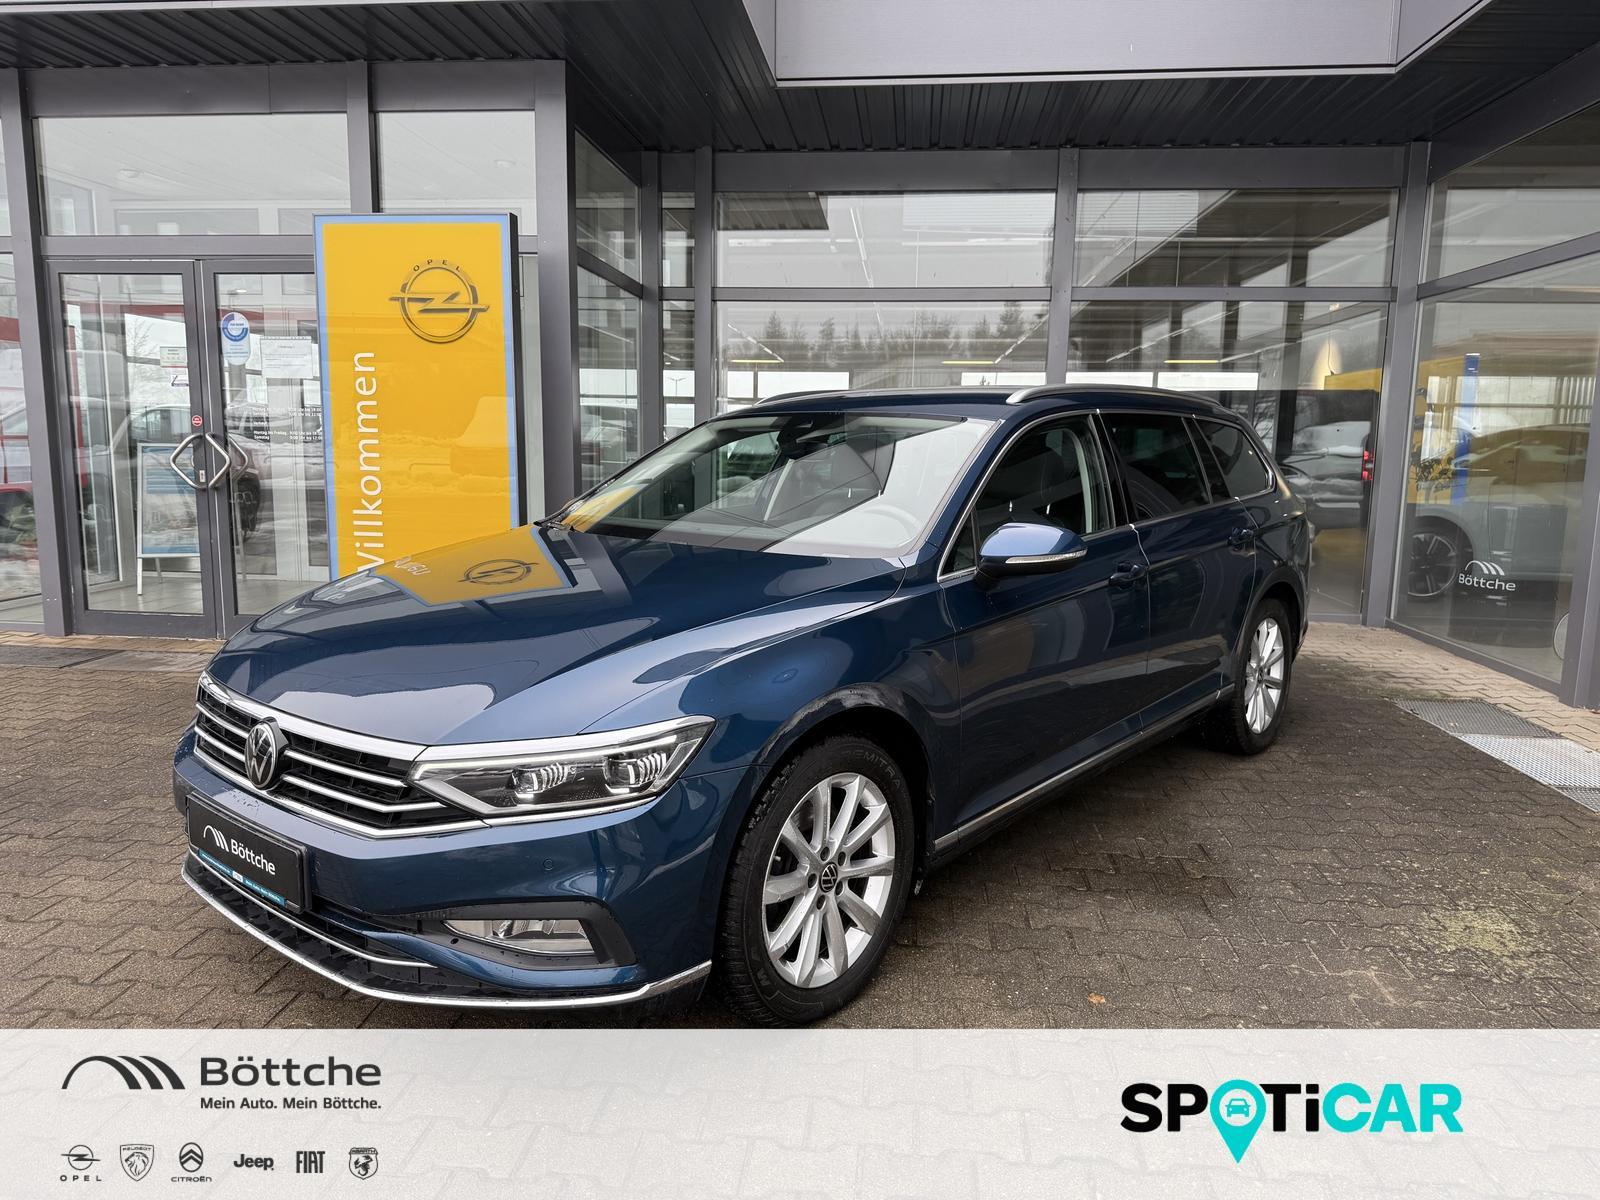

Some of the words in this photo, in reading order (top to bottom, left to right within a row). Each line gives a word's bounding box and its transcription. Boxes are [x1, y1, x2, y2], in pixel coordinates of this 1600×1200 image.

[413, 258, 460, 273] OPEL
[1458, 573, 1517, 591] Böttche
[230, 838, 276, 876] Böttche
